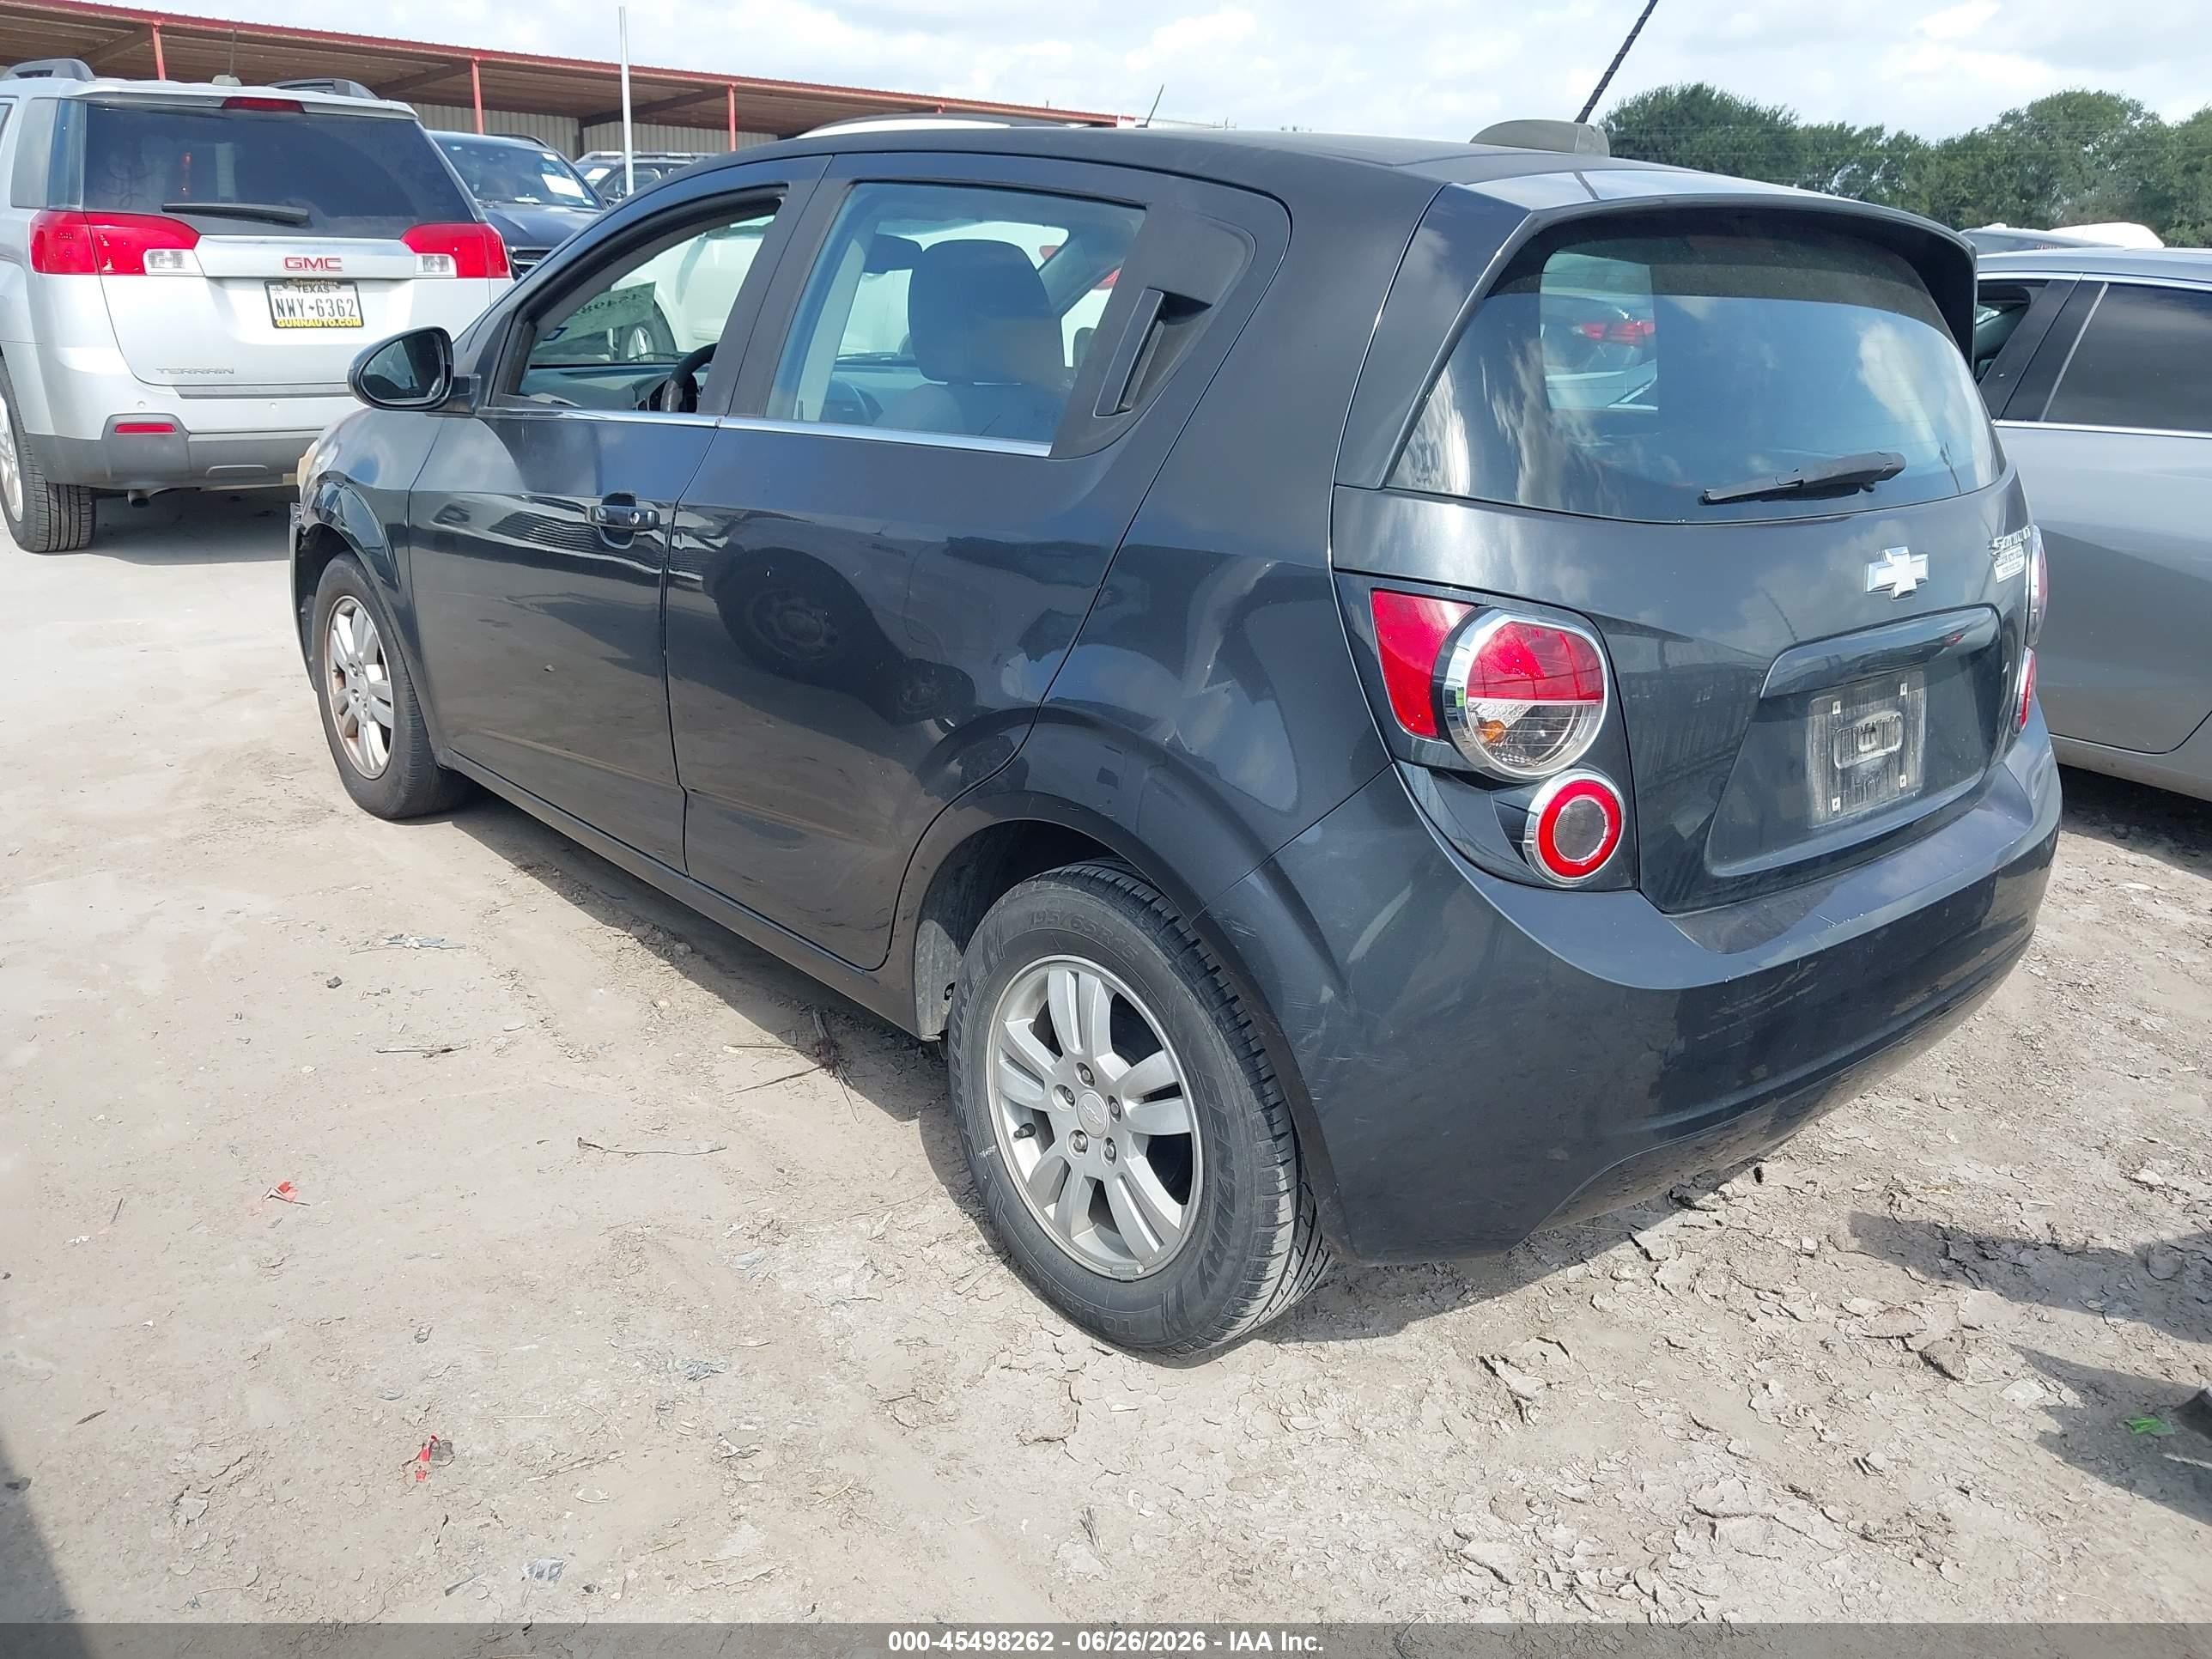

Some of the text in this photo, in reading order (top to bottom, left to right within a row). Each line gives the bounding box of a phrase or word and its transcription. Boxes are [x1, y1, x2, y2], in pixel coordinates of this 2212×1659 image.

[283, 256, 343, 272] GMC
[297, 284, 331, 295] TEXAS
[276, 319, 362, 327] GUNNAUTO.COM
